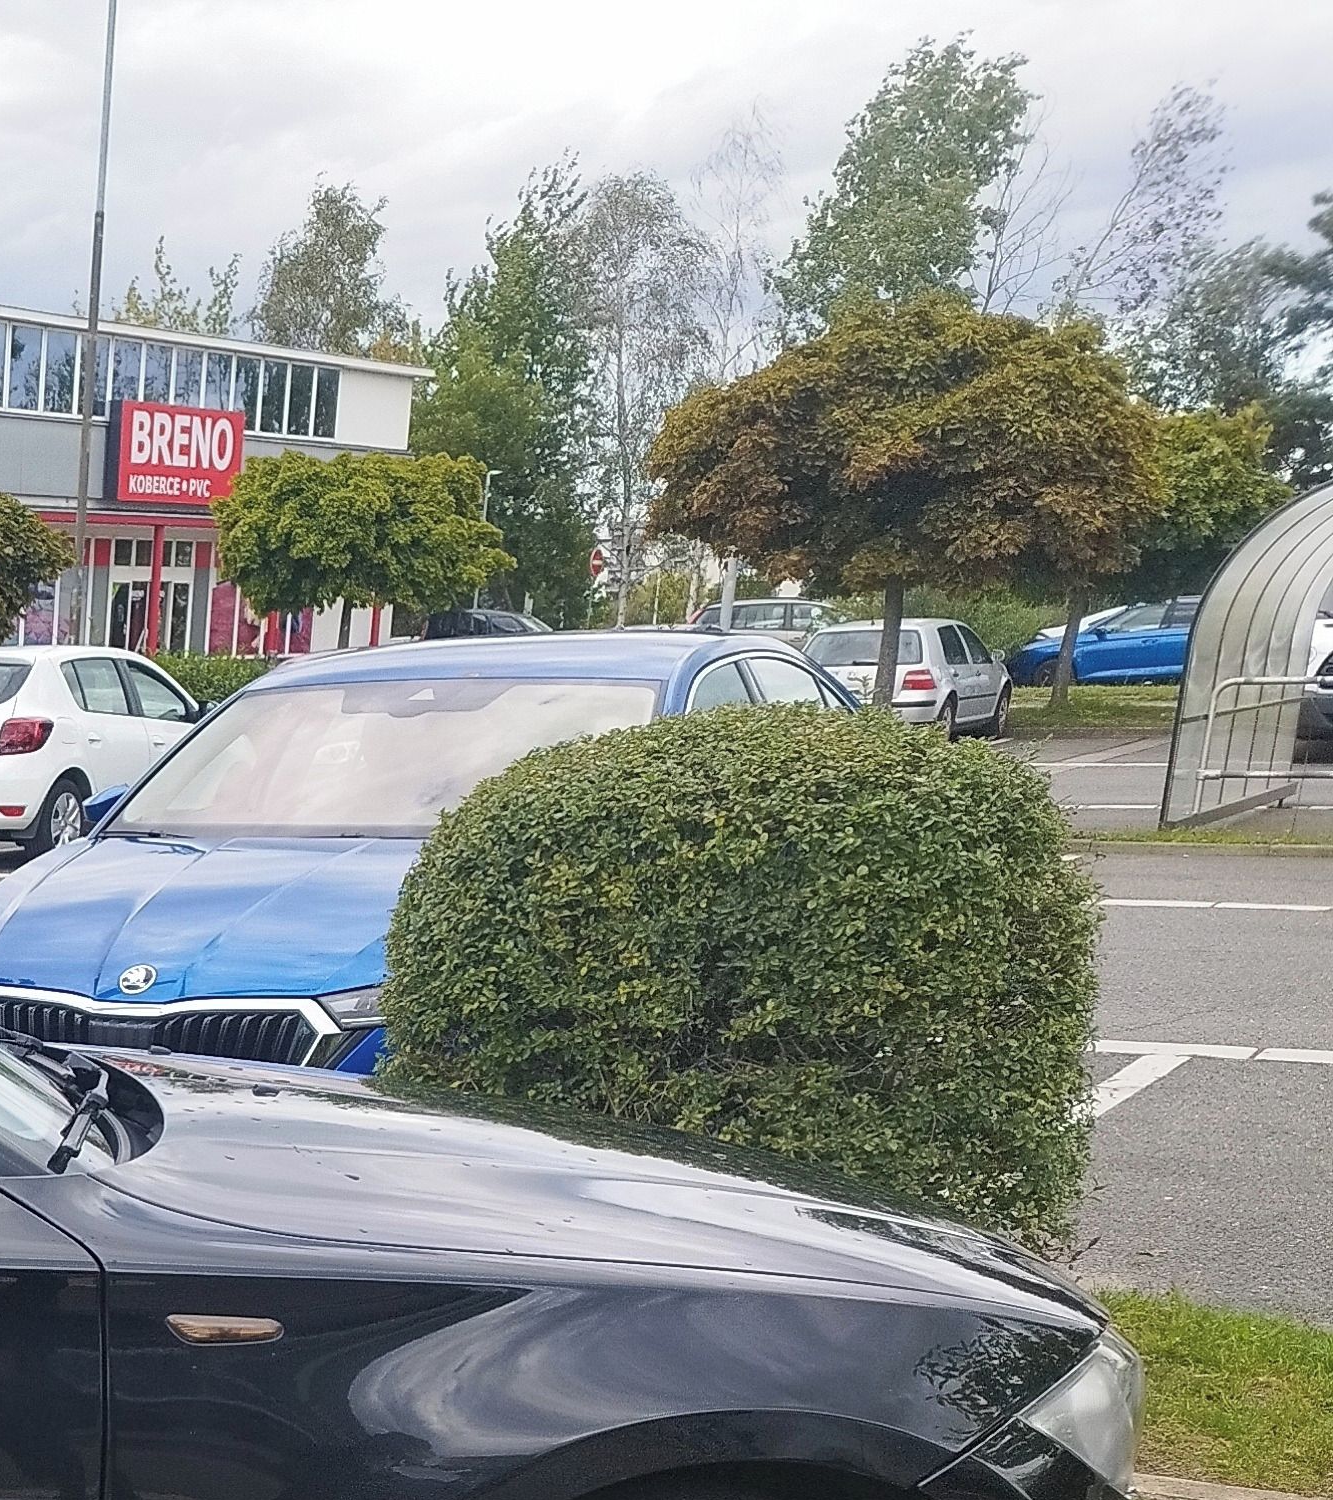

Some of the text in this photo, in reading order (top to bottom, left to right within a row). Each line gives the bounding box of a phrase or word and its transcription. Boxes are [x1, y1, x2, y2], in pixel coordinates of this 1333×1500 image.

[130, 409, 234, 472] BRENO
[128, 474, 212, 498] KOBERCE PVC
